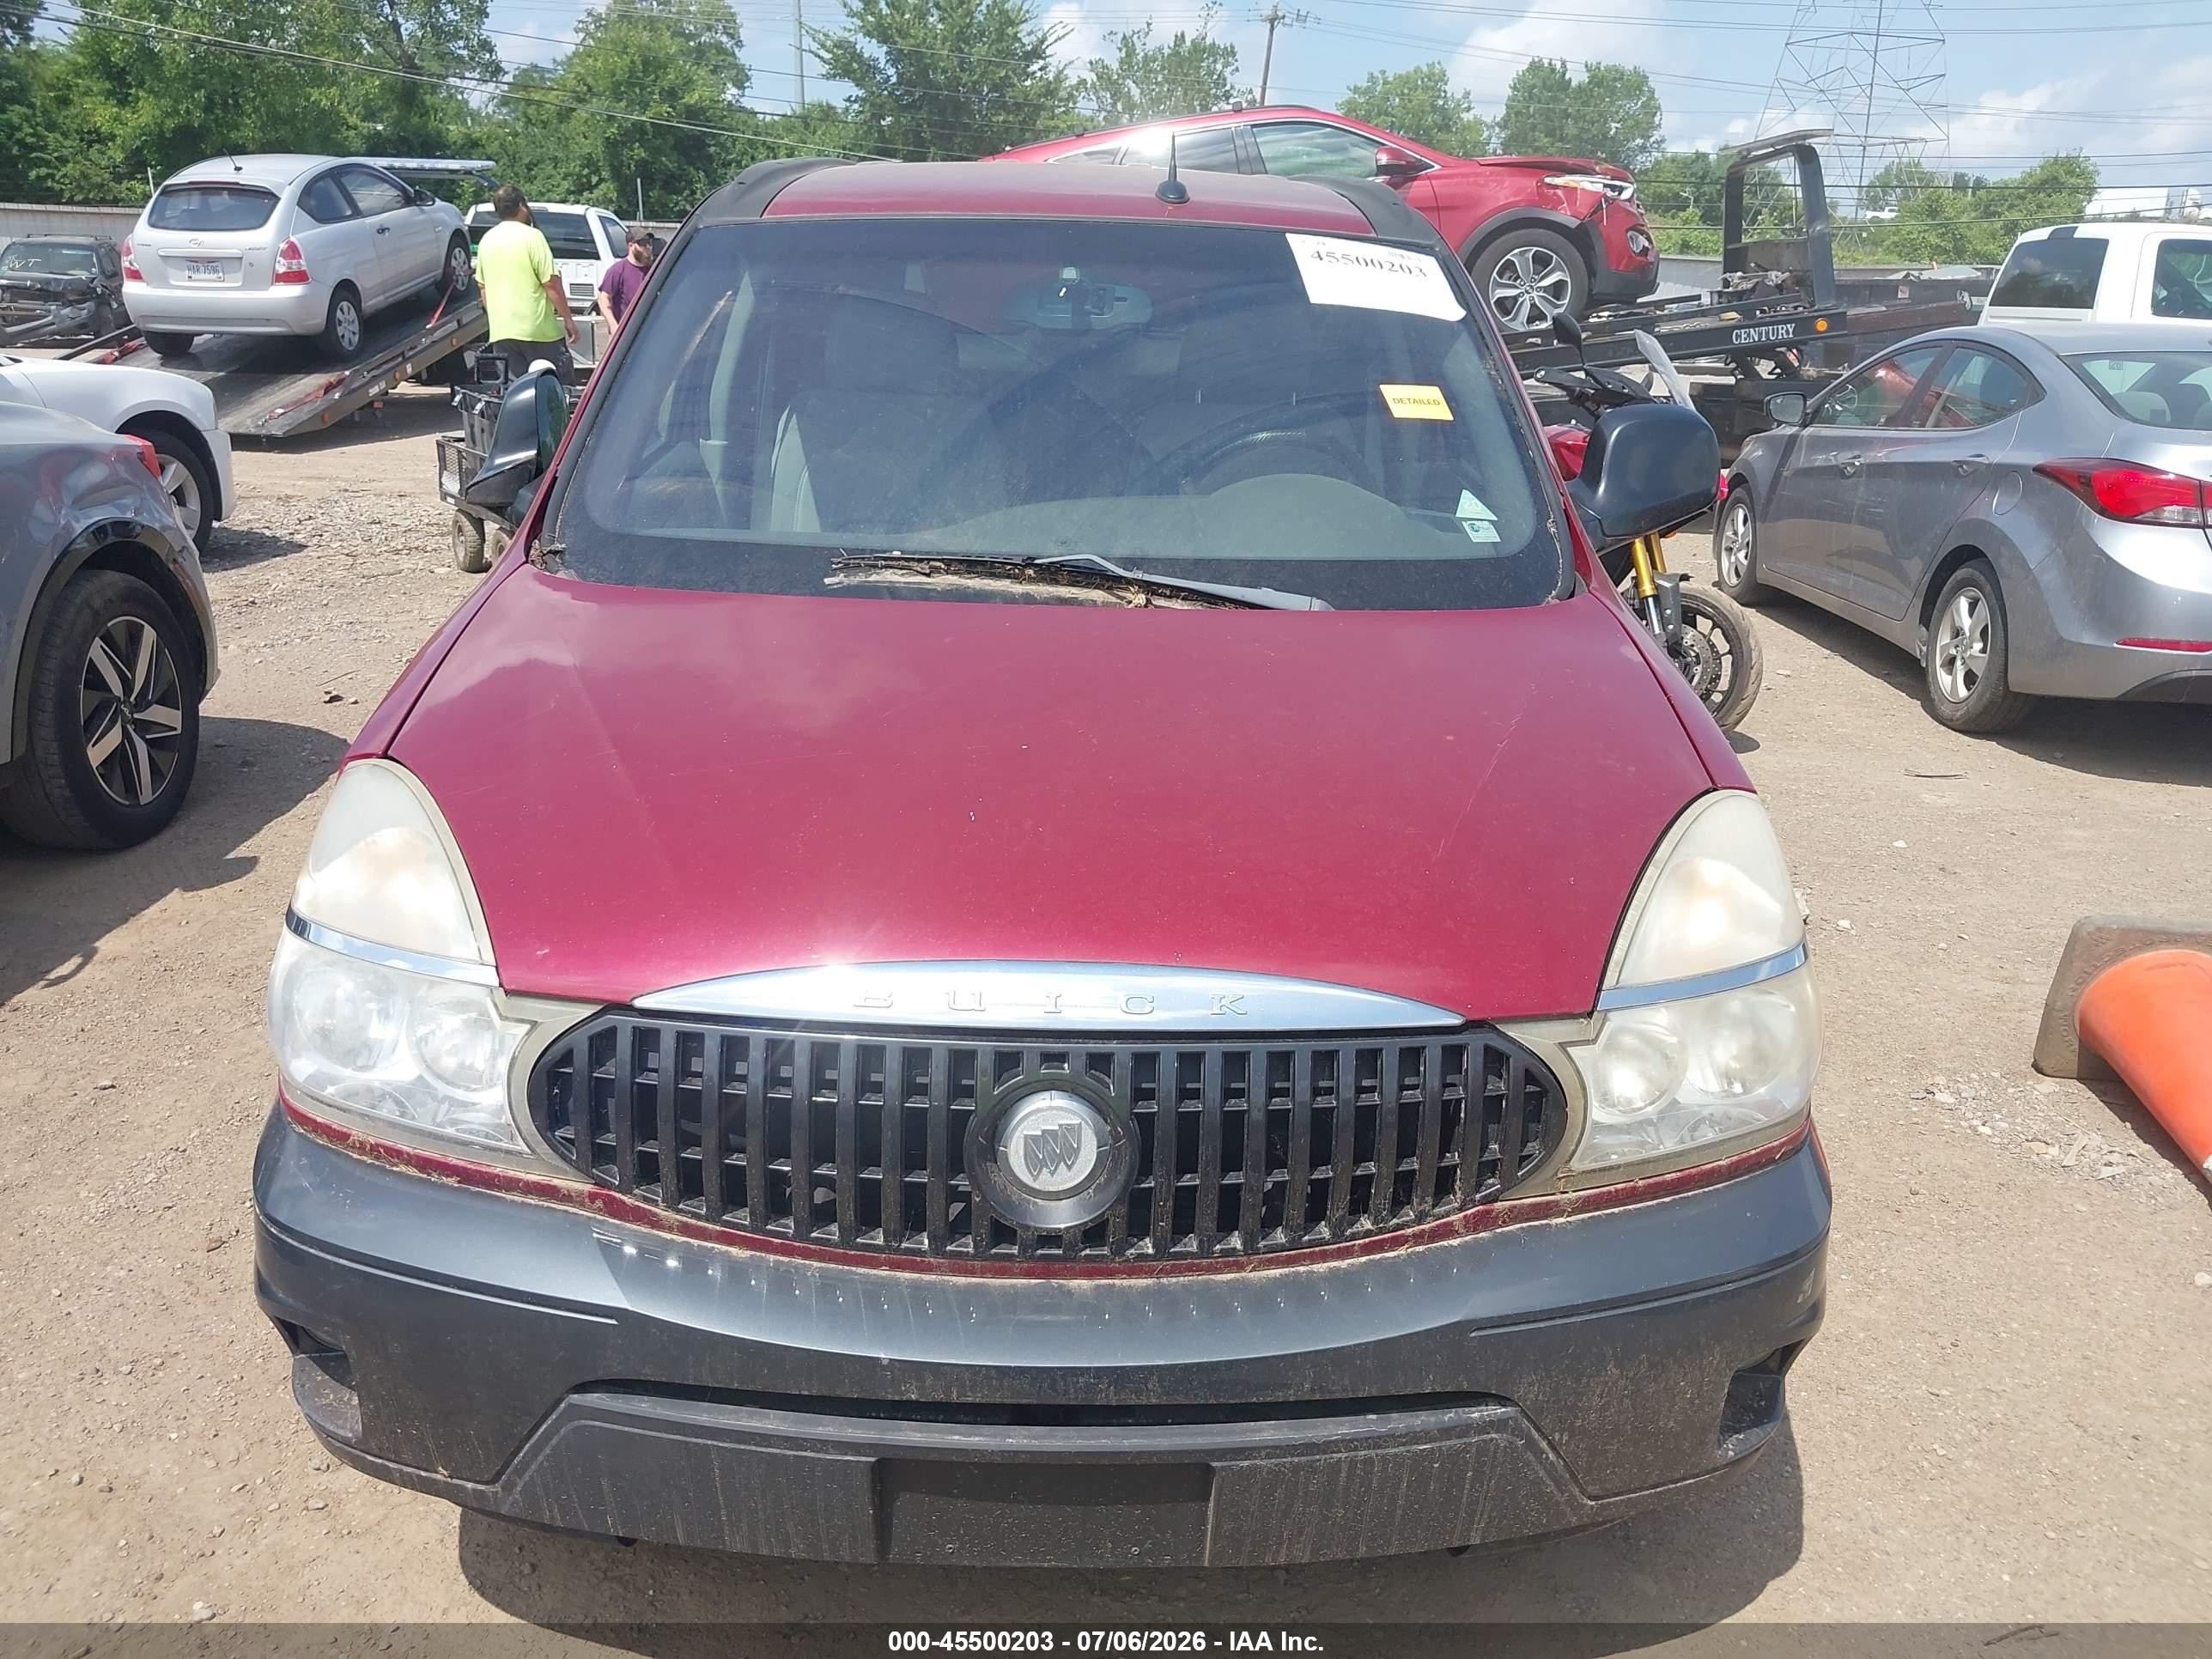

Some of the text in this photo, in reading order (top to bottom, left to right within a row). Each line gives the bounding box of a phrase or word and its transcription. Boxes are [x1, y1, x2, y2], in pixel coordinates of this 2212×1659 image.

[1310, 250, 1428, 277] 45500203
[1732, 323, 1796, 343] CENTURY
[1392, 398, 1440, 406] DETAILED
[853, 988, 1249, 1016] BUICK
